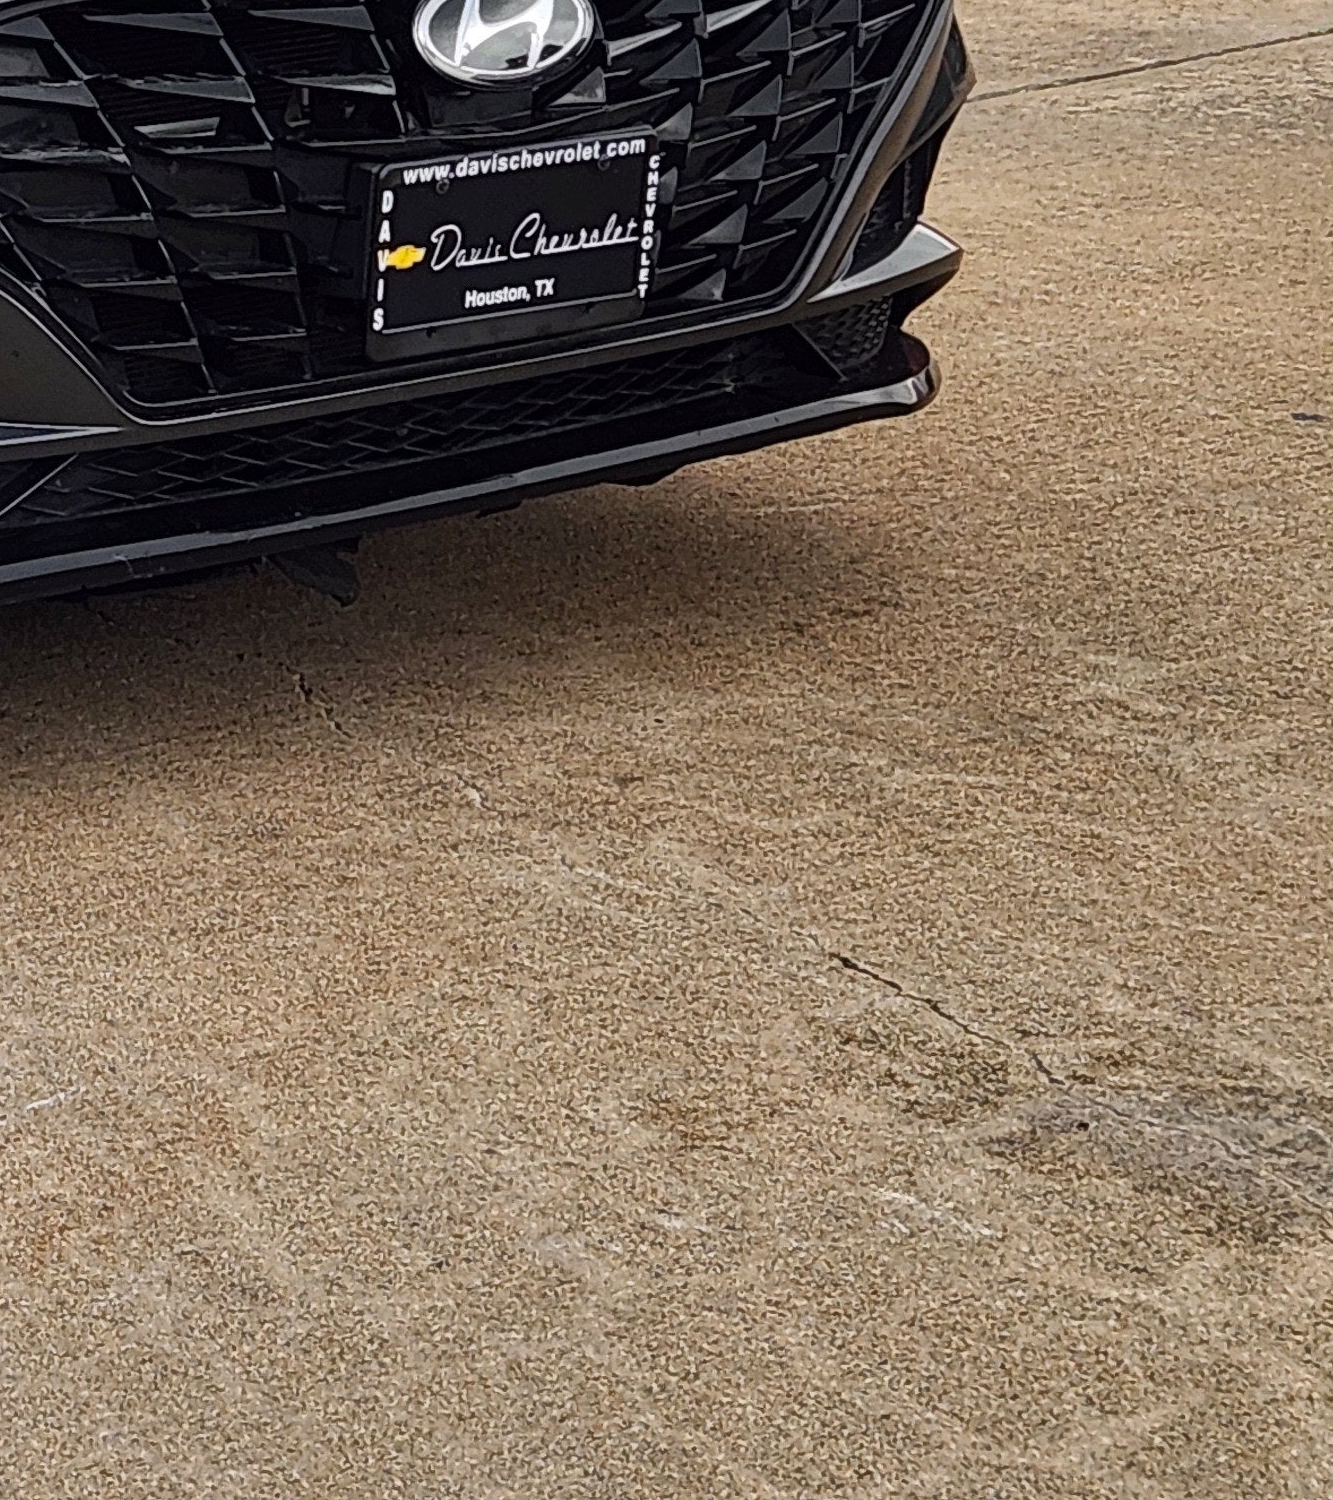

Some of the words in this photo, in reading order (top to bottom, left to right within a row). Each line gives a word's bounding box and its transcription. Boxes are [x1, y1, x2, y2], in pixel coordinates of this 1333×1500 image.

[403, 138, 646, 186] www.davischevrolet.com
[430, 224, 508, 271] Davis
[509, 212, 640, 259] Chevrolet
[637, 155, 661, 299] CHEVROLET
[372, 190, 394, 331] DAVIS
[465, 285, 531, 308] Houston,
[535, 278, 555, 297] TX
